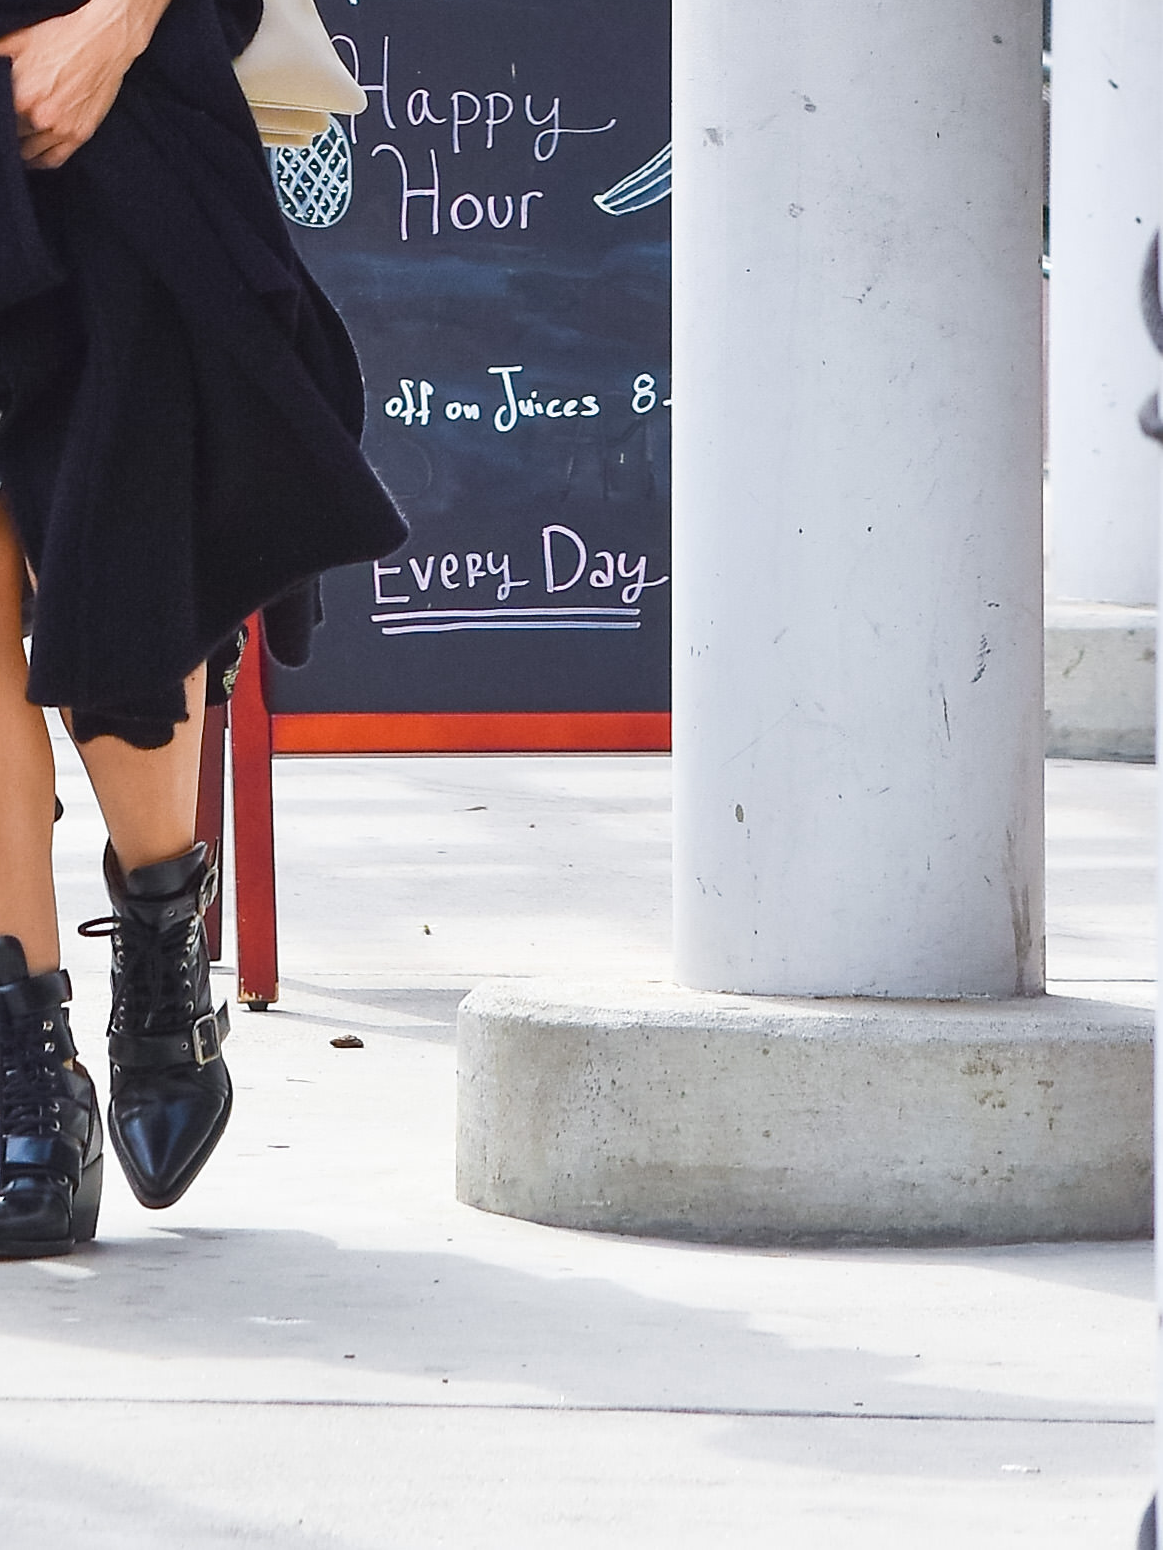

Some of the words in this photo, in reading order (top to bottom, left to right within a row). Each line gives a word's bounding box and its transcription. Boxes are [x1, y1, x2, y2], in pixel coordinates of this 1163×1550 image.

[330, 34, 617, 161] Happy
[370, 142, 544, 241] Hour
[384, 378, 434, 426] off
[445, 400, 480, 421] on
[487, 364, 601, 432] Juices
[541, 523, 670, 604] Day
